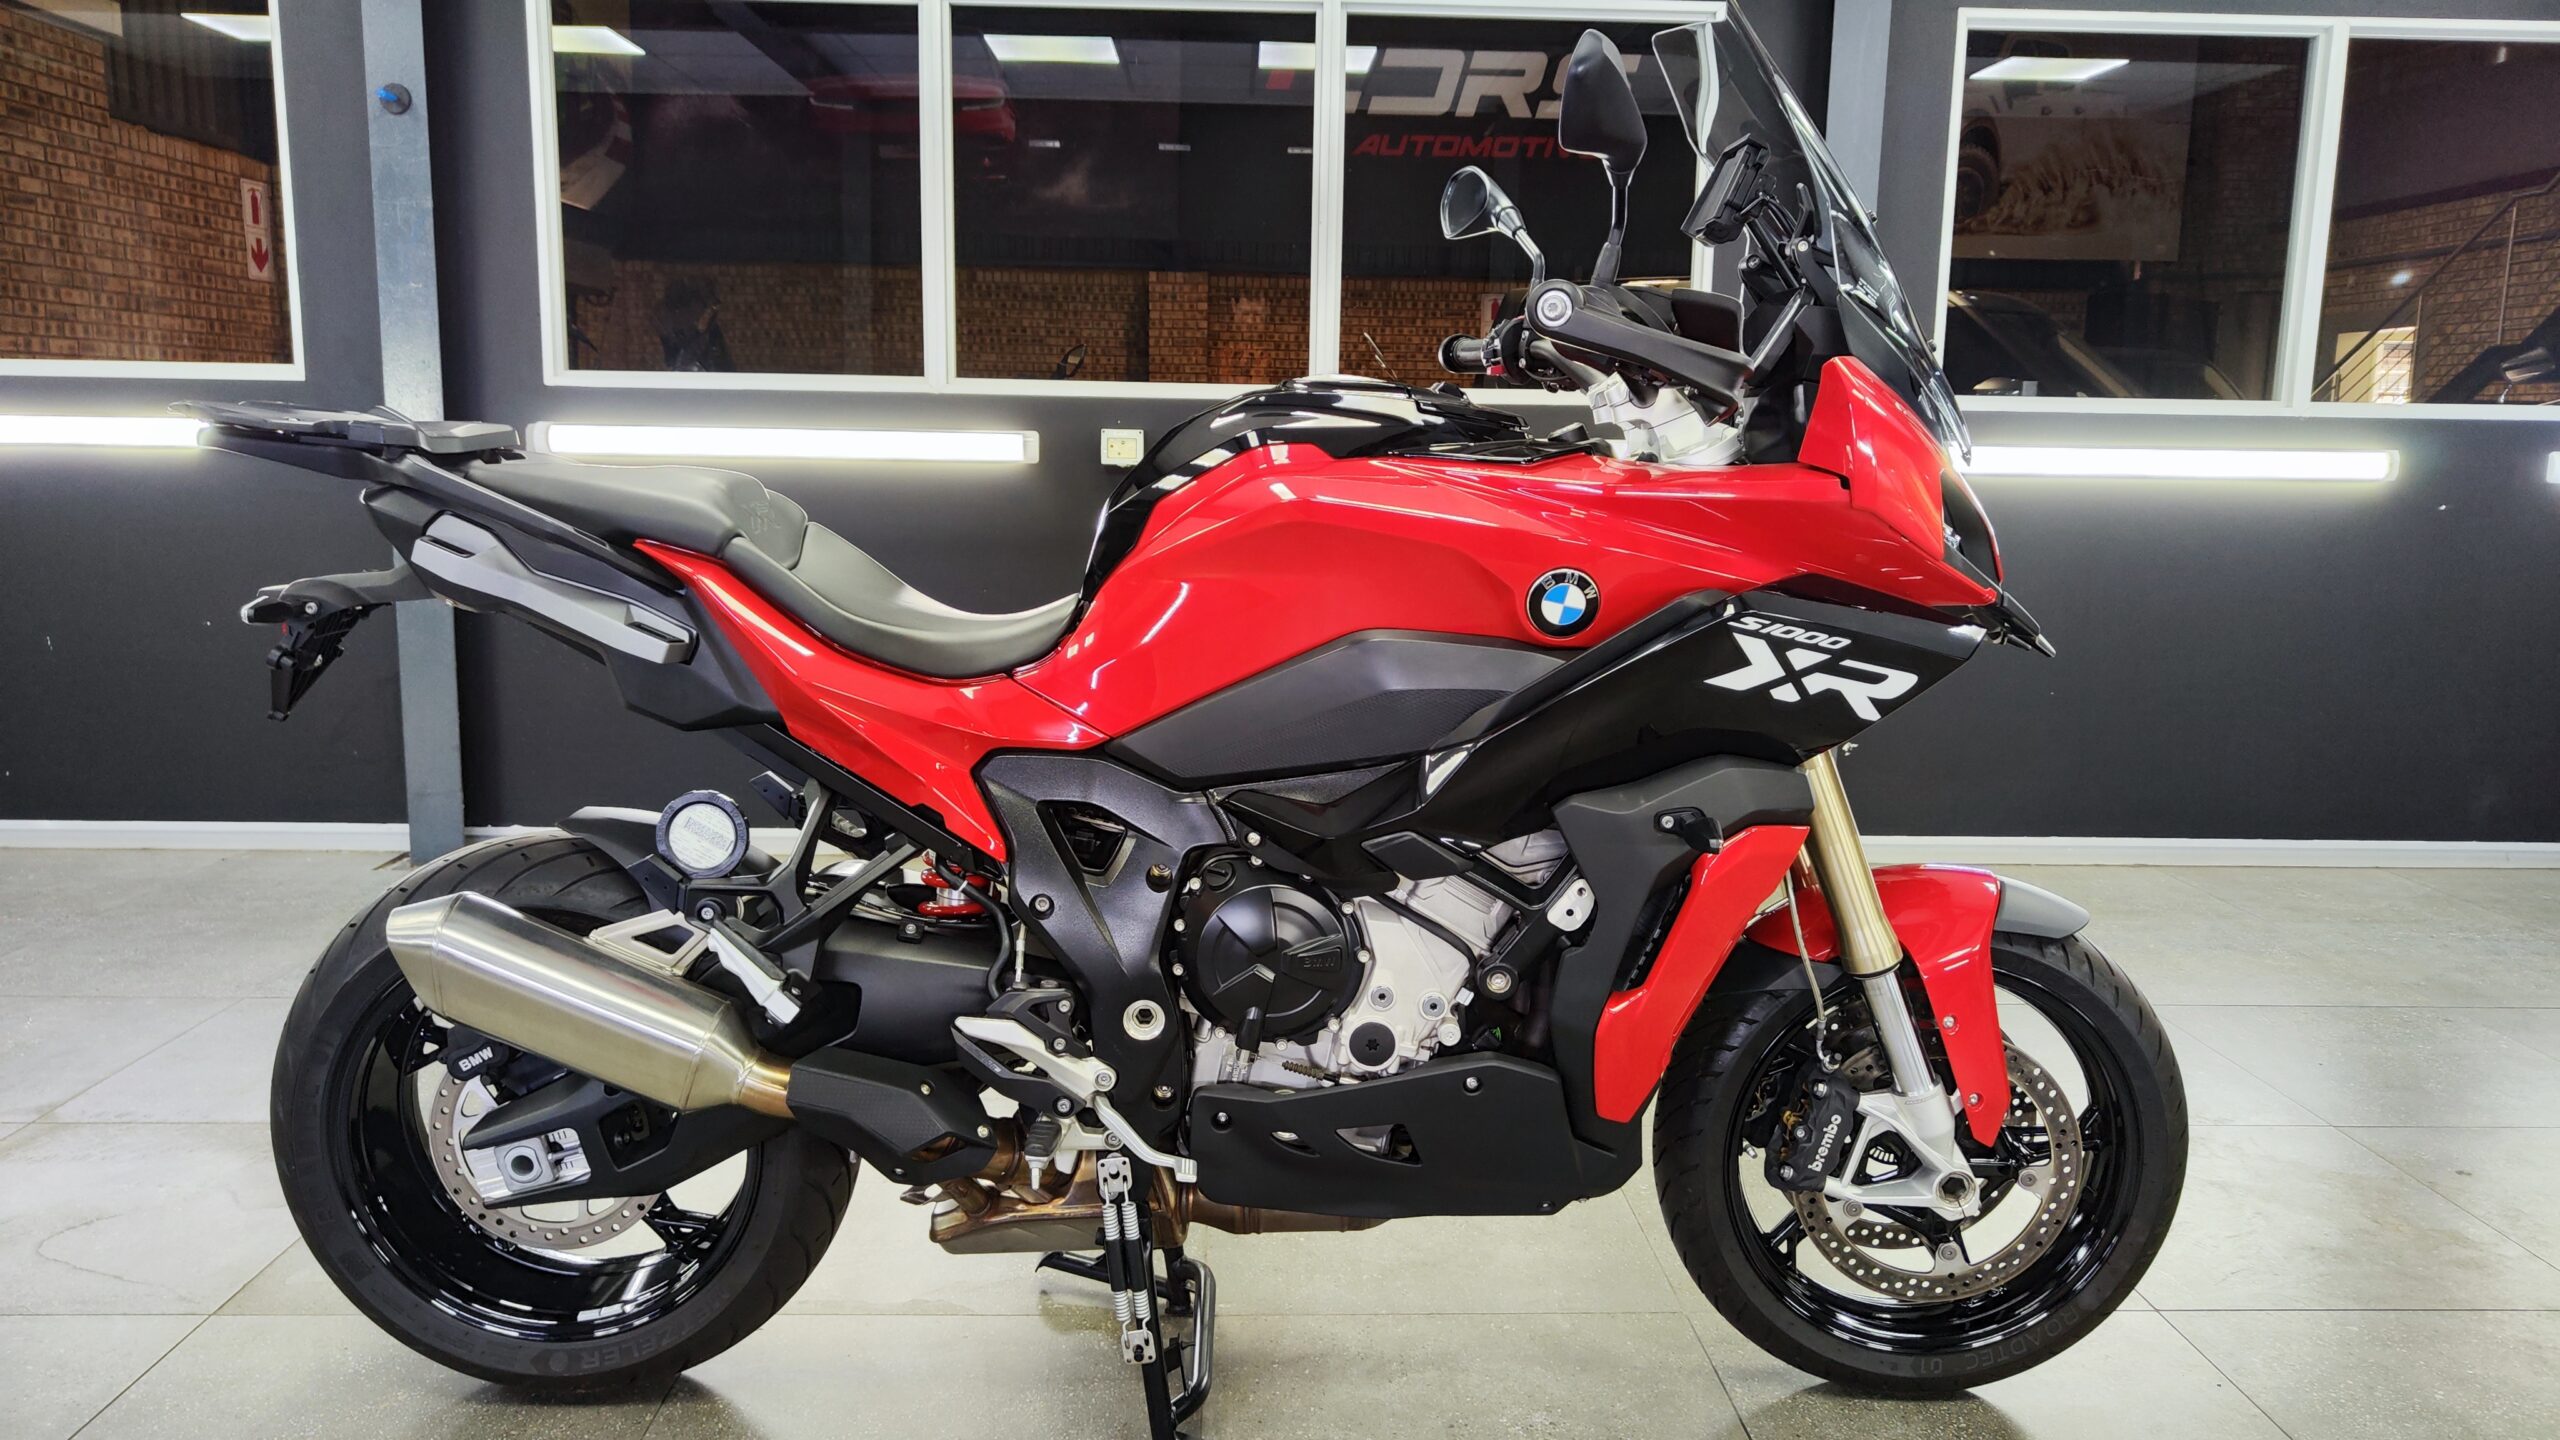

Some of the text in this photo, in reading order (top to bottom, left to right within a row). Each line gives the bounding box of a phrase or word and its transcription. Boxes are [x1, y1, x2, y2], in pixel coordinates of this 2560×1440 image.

[1353, 134, 1597, 160] AUTOMOTI
[1541, 571, 1597, 600] BMW
[1727, 616, 1852, 649] S1000
[1703, 632, 1919, 721] XR
[458, 1046, 494, 1072] BMW
[1807, 1114, 1842, 1172] brembo
[1964, 1305, 2080, 1371] ROADTEC
